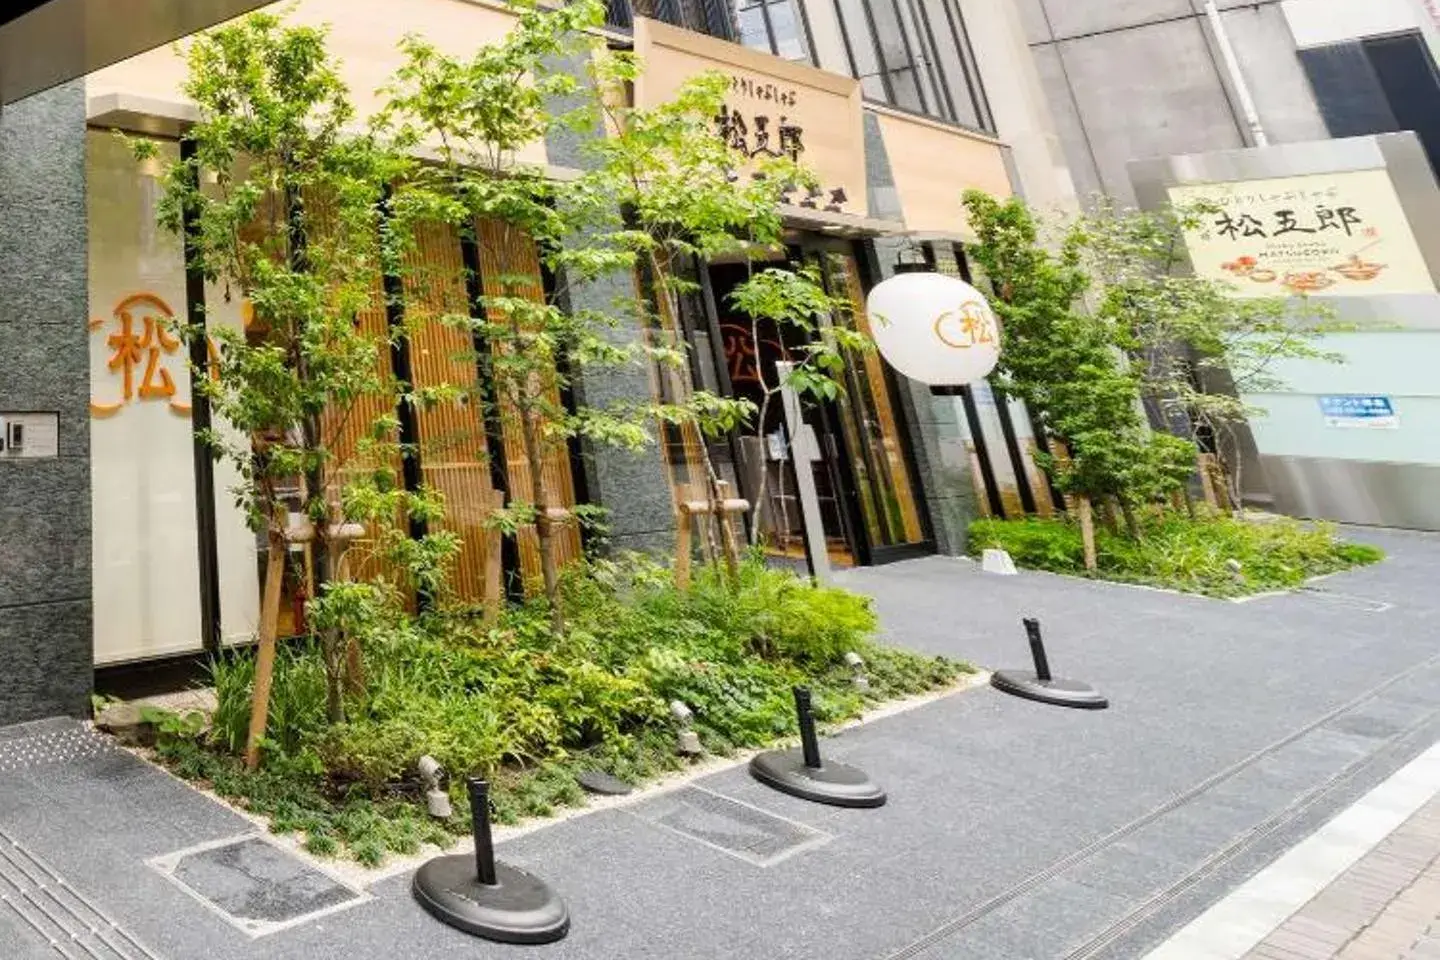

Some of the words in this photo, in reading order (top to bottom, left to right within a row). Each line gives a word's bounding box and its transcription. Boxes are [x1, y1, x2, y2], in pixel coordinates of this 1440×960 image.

[714, 103, 805, 163] 松五郎
[1215, 204, 1362, 242] 松五郎
[960, 309, 993, 344] 松
[106, 310, 180, 401] 松
